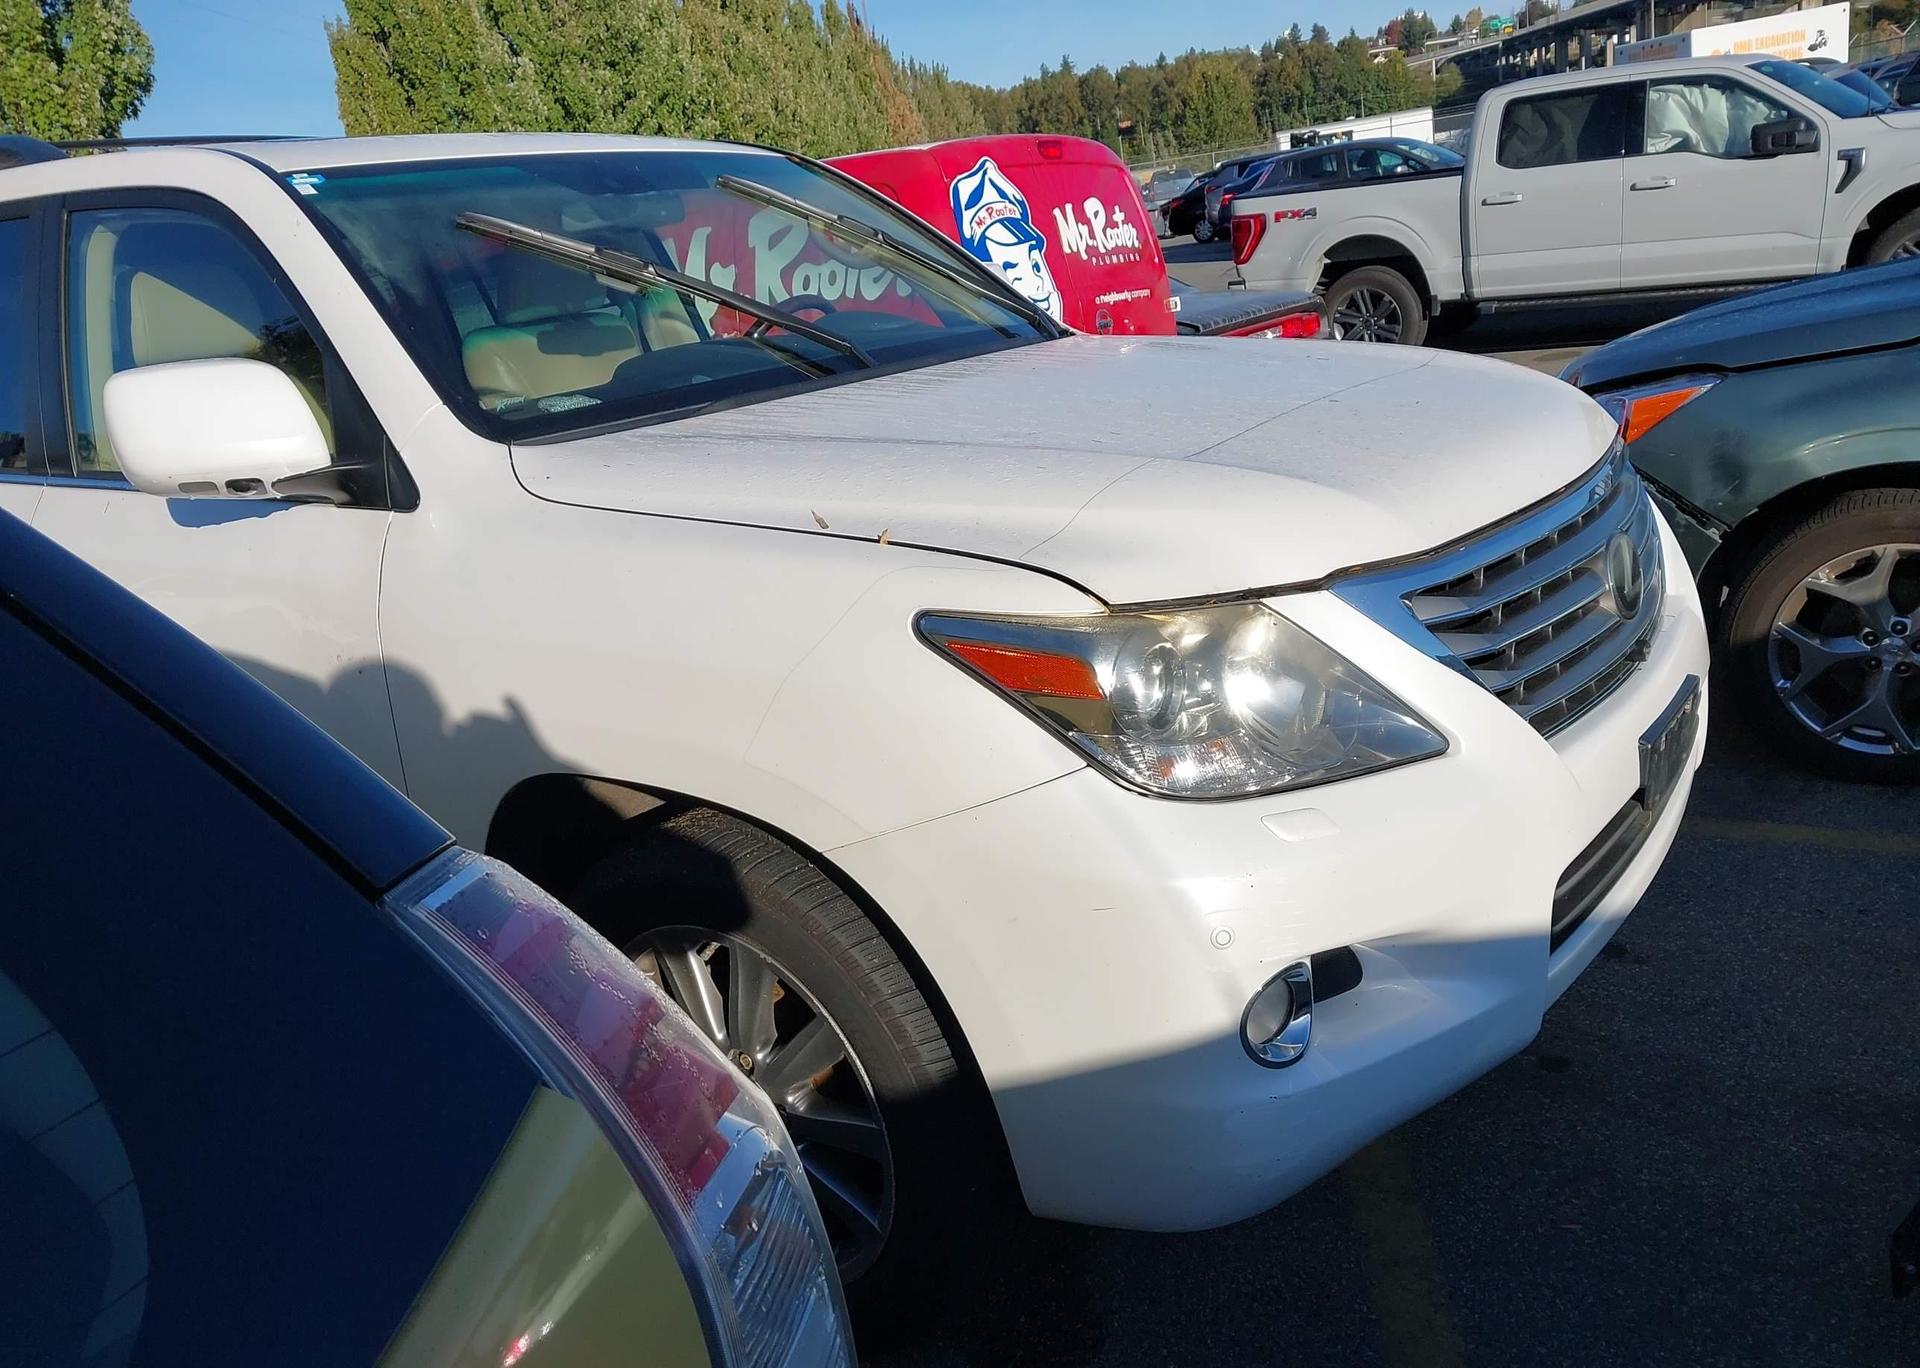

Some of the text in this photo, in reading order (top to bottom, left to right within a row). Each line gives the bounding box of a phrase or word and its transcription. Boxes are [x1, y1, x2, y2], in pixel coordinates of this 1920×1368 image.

[1755, 29, 1807, 50] EXCAVATION
[985, 203, 1017, 220] Rooter
[1274, 207, 1317, 223] FX4
[1083, 197, 1139, 254] Rooter
[1091, 252, 1141, 267] PLUMBING
